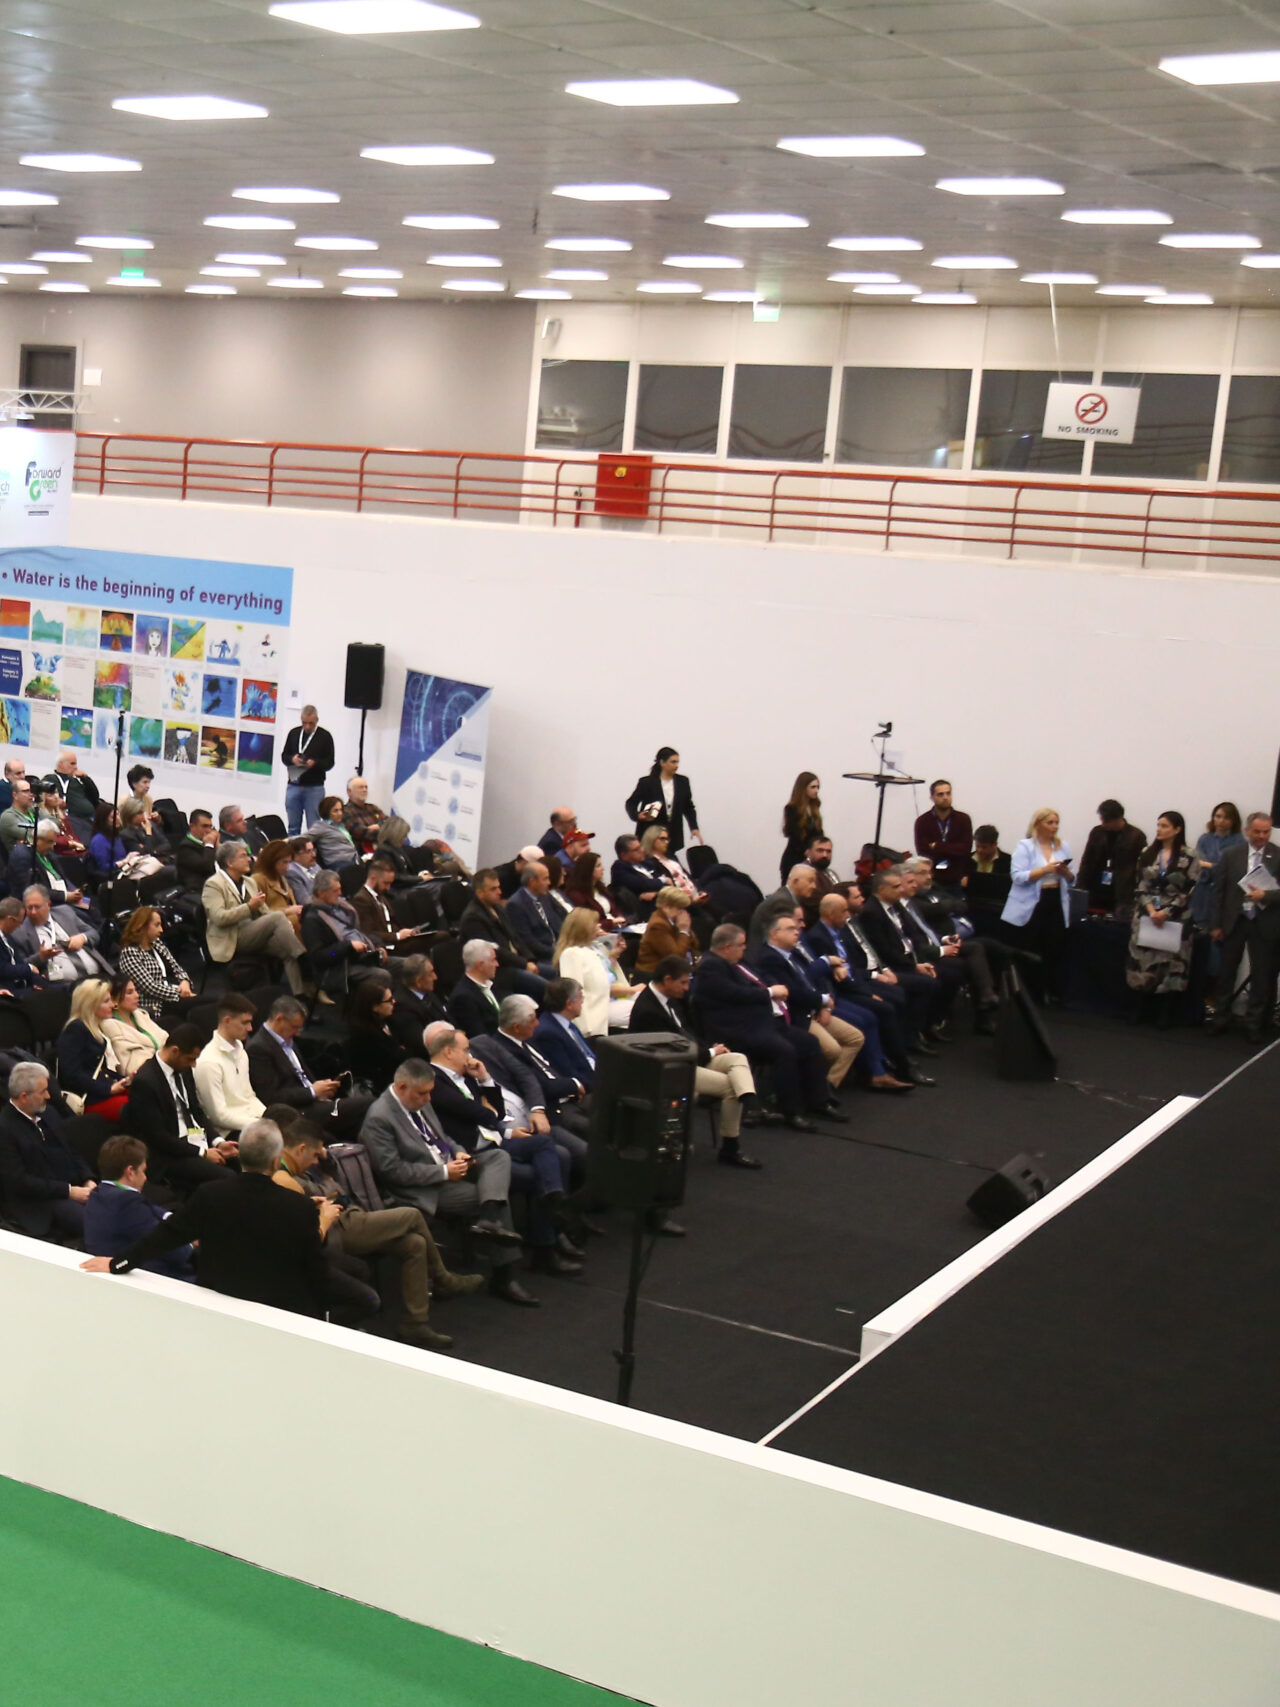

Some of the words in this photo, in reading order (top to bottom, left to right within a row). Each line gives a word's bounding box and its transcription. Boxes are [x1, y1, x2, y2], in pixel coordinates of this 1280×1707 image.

[1076, 426, 1119, 436] SMOKING
[13, 568, 55, 587] Water
[58, 573, 70, 588] is
[75, 576, 98, 591] the
[103, 578, 175, 603] beginning
[180, 586, 195, 601] of
[199, 591, 284, 615] everything
